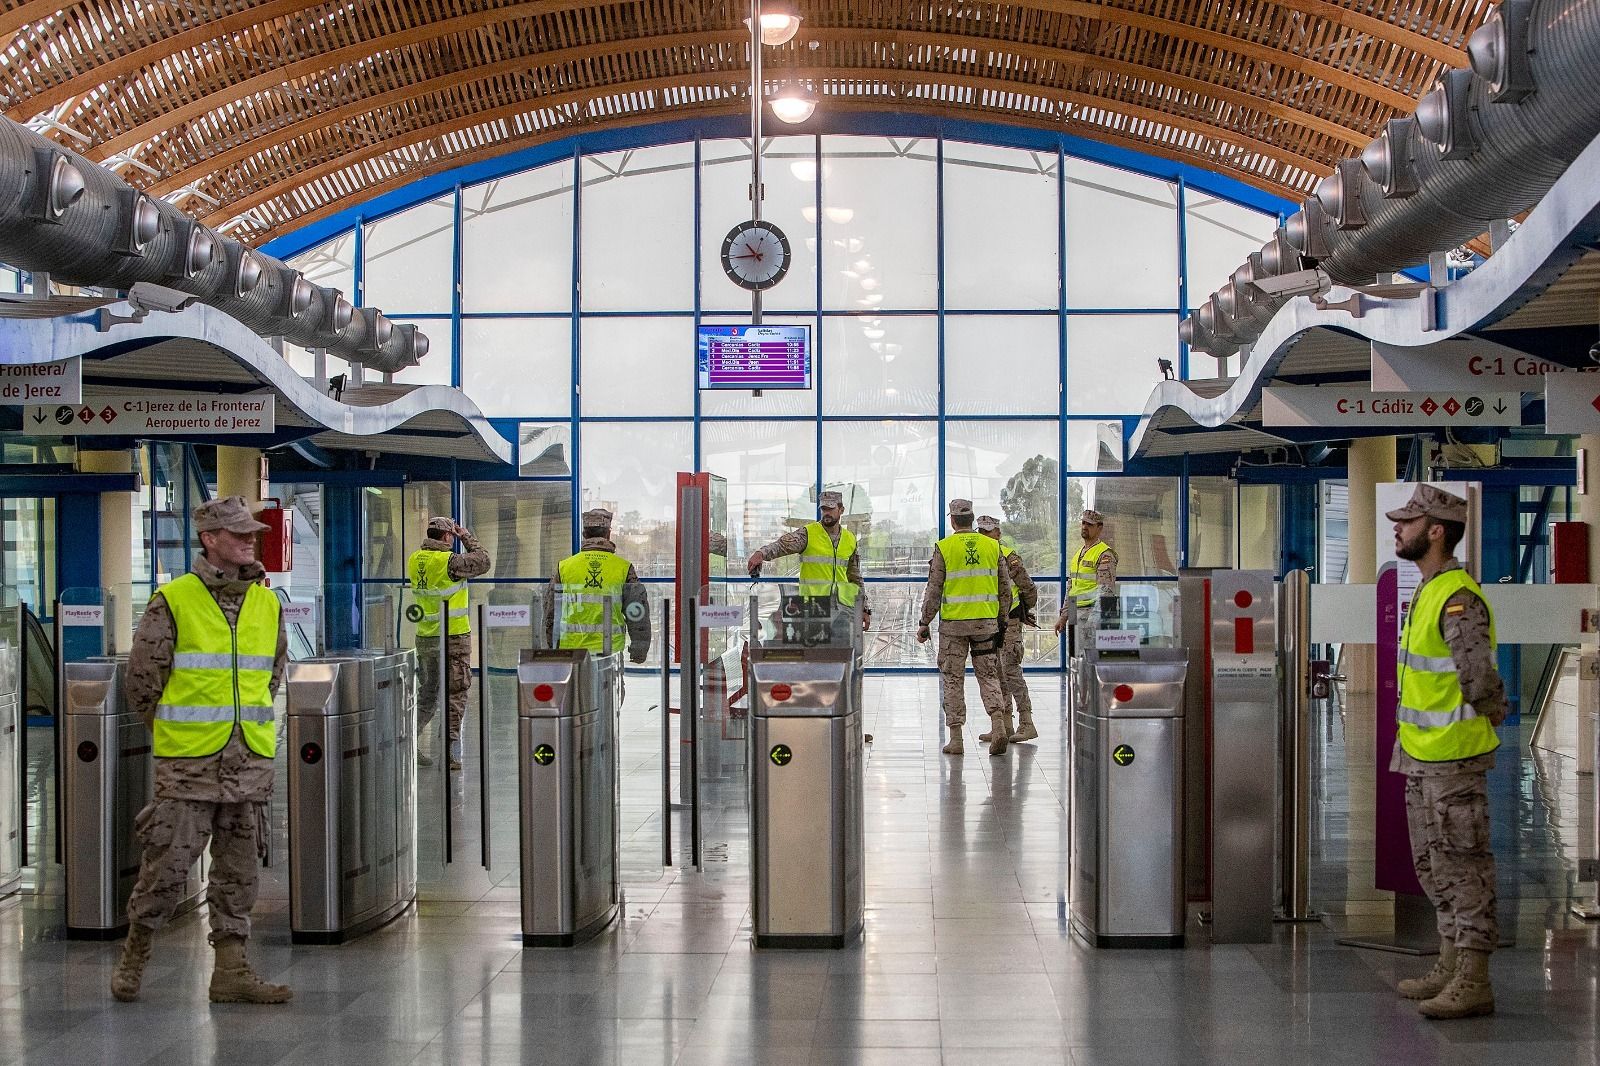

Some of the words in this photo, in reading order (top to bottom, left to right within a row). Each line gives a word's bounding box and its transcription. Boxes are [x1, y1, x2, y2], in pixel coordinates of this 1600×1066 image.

[1468, 355, 1506, 376] C-1
[2, 383, 20, 398] de
[24, 384, 61, 400] Jerez
[123, 401, 143, 412] C-1
[146, 401, 174, 414] Jerez
[178, 400, 192, 412] de
[196, 400, 207, 412] la
[211, 400, 265, 412] Frontera/
[1336, 398, 1365, 414] C-1
[1371, 398, 1414, 414] Cádiz
[1426, 402, 1433, 412] 2
[1448, 402, 1455, 412] 4
[83, 409, 90, 421] 1
[104, 409, 112, 421] 3
[145, 416, 210, 430] Aeropuerto
[214, 416, 228, 428] de
[231, 416, 261, 429] Jerez
